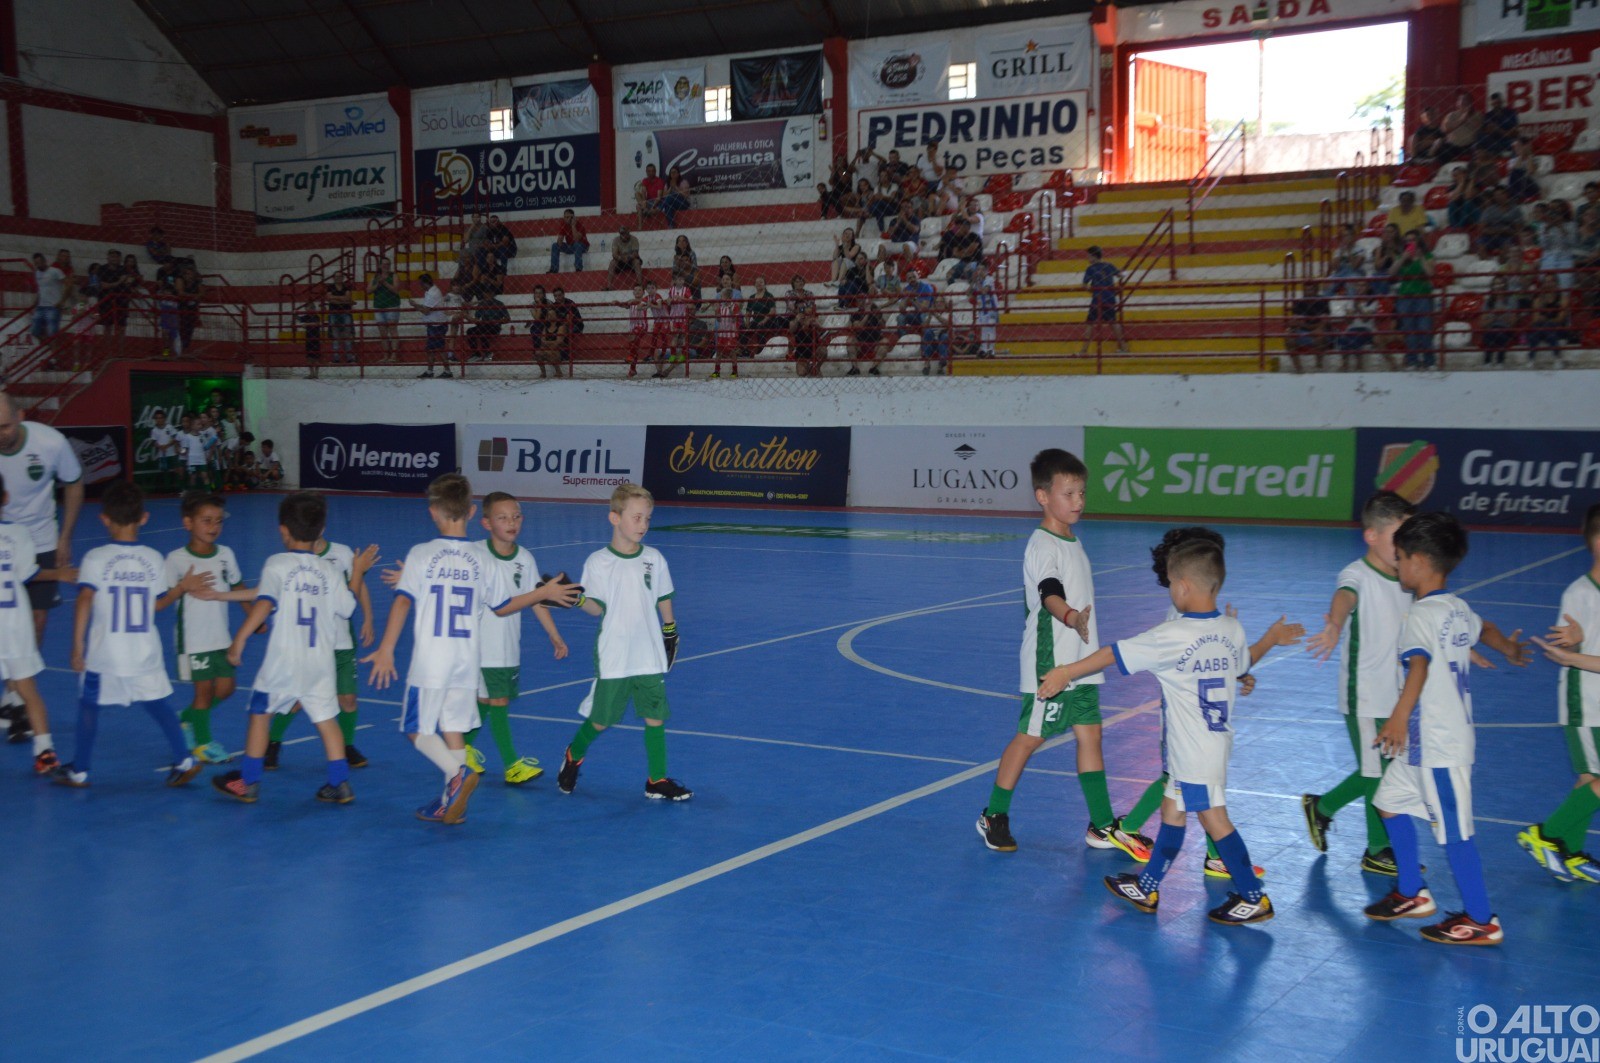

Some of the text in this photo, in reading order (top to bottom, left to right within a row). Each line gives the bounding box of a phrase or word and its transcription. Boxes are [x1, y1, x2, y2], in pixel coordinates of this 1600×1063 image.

[1202, 0, 1331, 28] SADA
[991, 52, 1073, 79] GRILL
[1506, 74, 1600, 113] BER
[325, 119, 386, 138] RaiMed
[421, 113, 448, 132] São
[868, 99, 1078, 150] PEDRINHO
[488, 141, 575, 173] O ALTO
[665, 148, 774, 178] Confiança
[976, 145, 1064, 170] Peças
[264, 164, 387, 202] Grafimax
[434, 149, 474, 200] 50
[478, 168, 576, 196] URUGUAI
[349, 443, 441, 469] Hermes
[670, 433, 822, 473] Marathon
[912, 468, 1019, 490] LUGANO
[1162, 452, 1335, 498] Sicredi
[1458, 492, 1571, 517] de futsal
[108, 586, 150, 633] 10
[297, 598, 317, 647] 4
[430, 585, 474, 639] 12
[1176, 634, 1219, 672] ESCOLINHA
[1192, 657, 1229, 673] AABB
